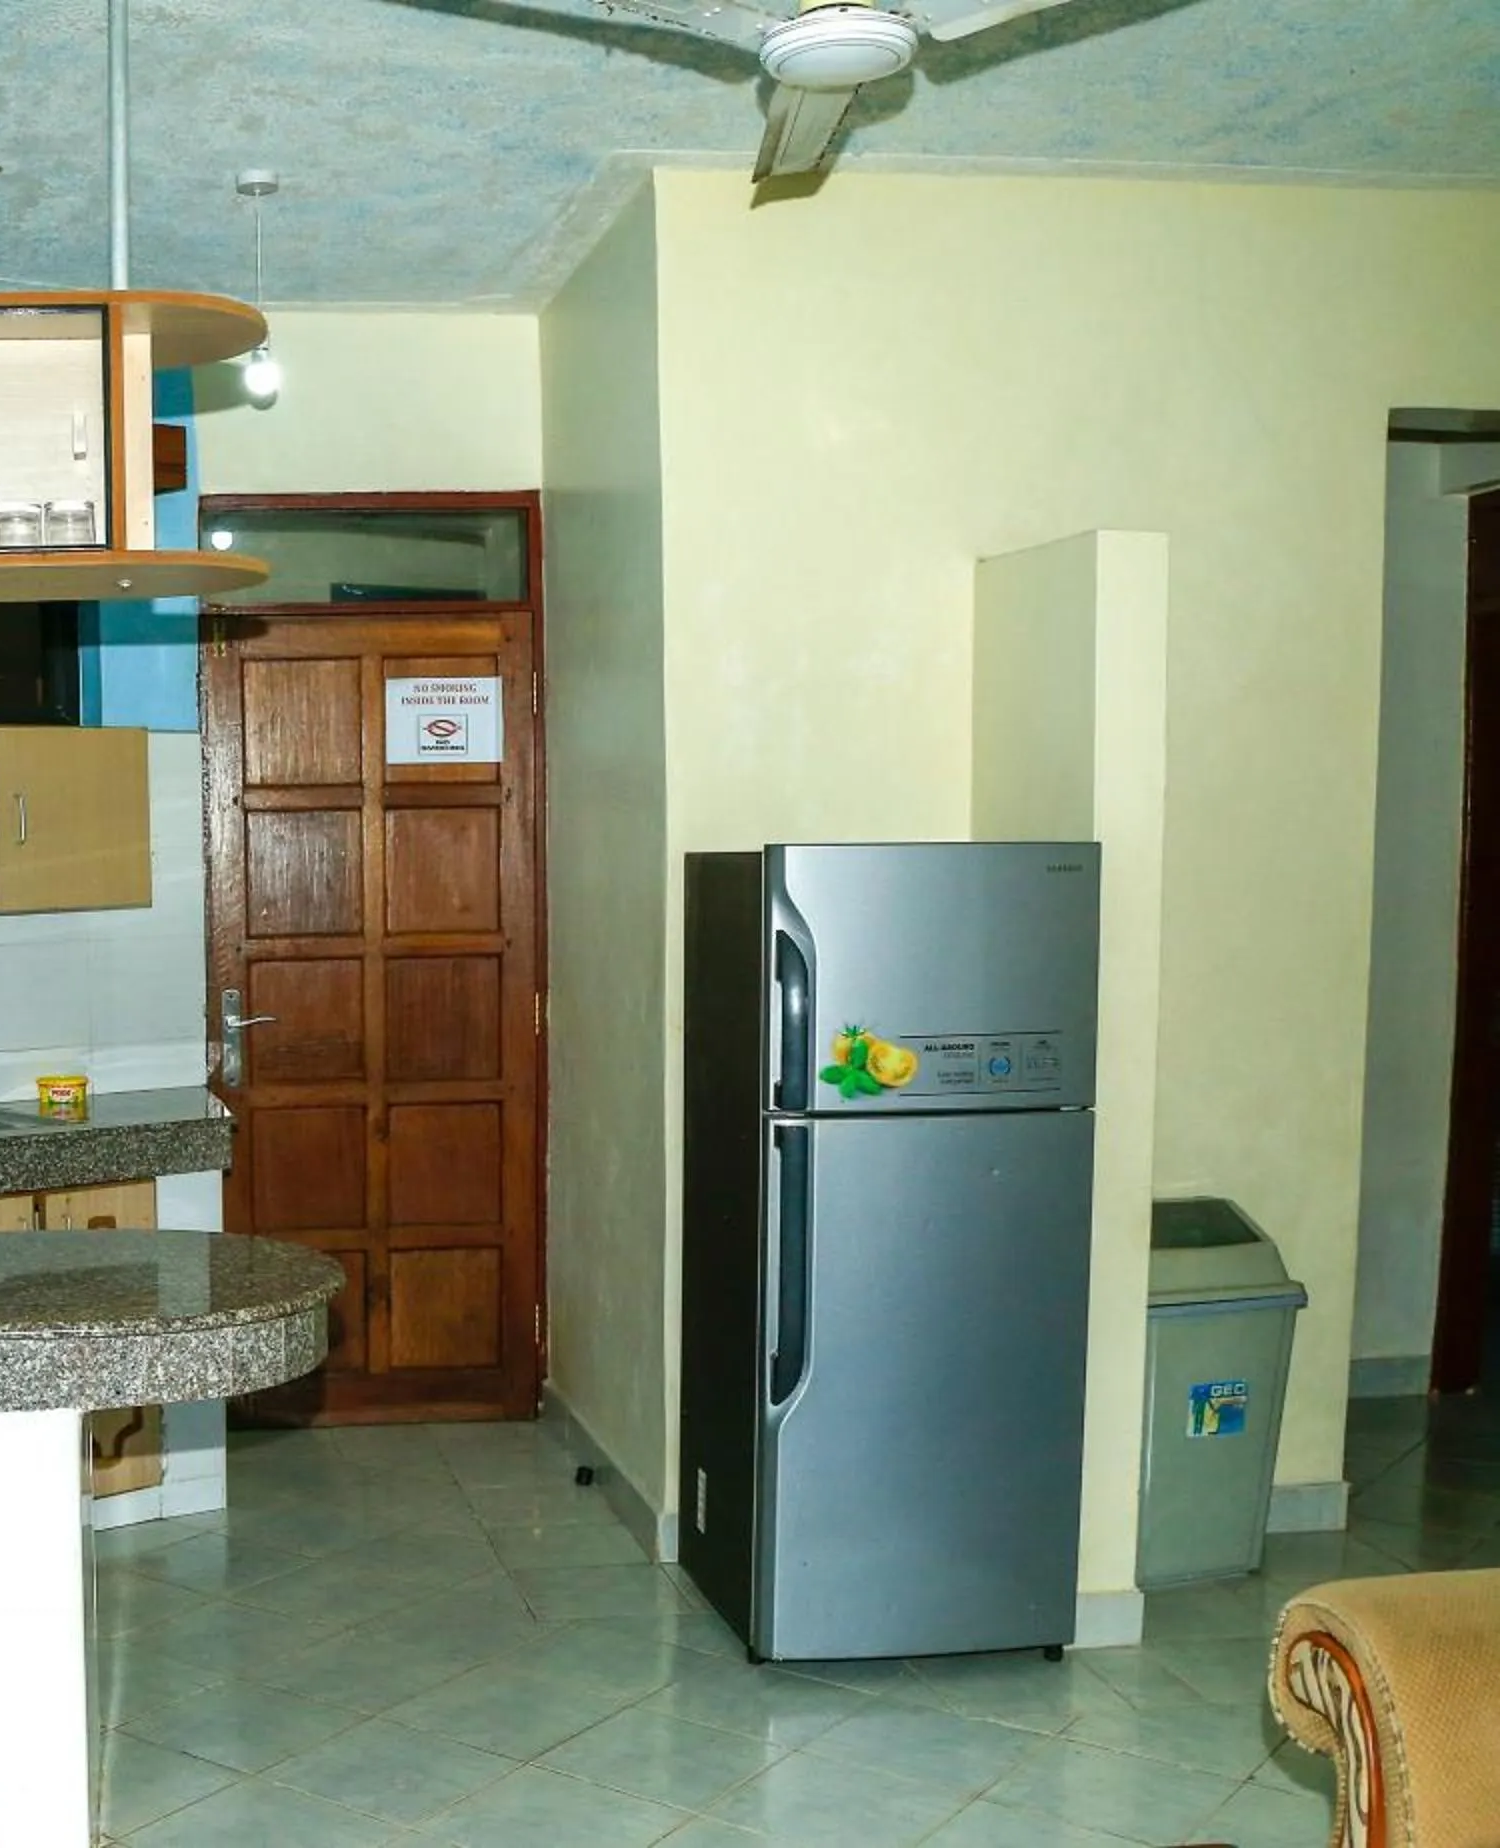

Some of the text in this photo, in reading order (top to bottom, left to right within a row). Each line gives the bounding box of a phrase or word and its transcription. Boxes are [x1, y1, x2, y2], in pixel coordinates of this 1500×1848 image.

[413, 683, 477, 693] NO SMOKING
[401, 695, 490, 705] INSIDE THE ROOM
